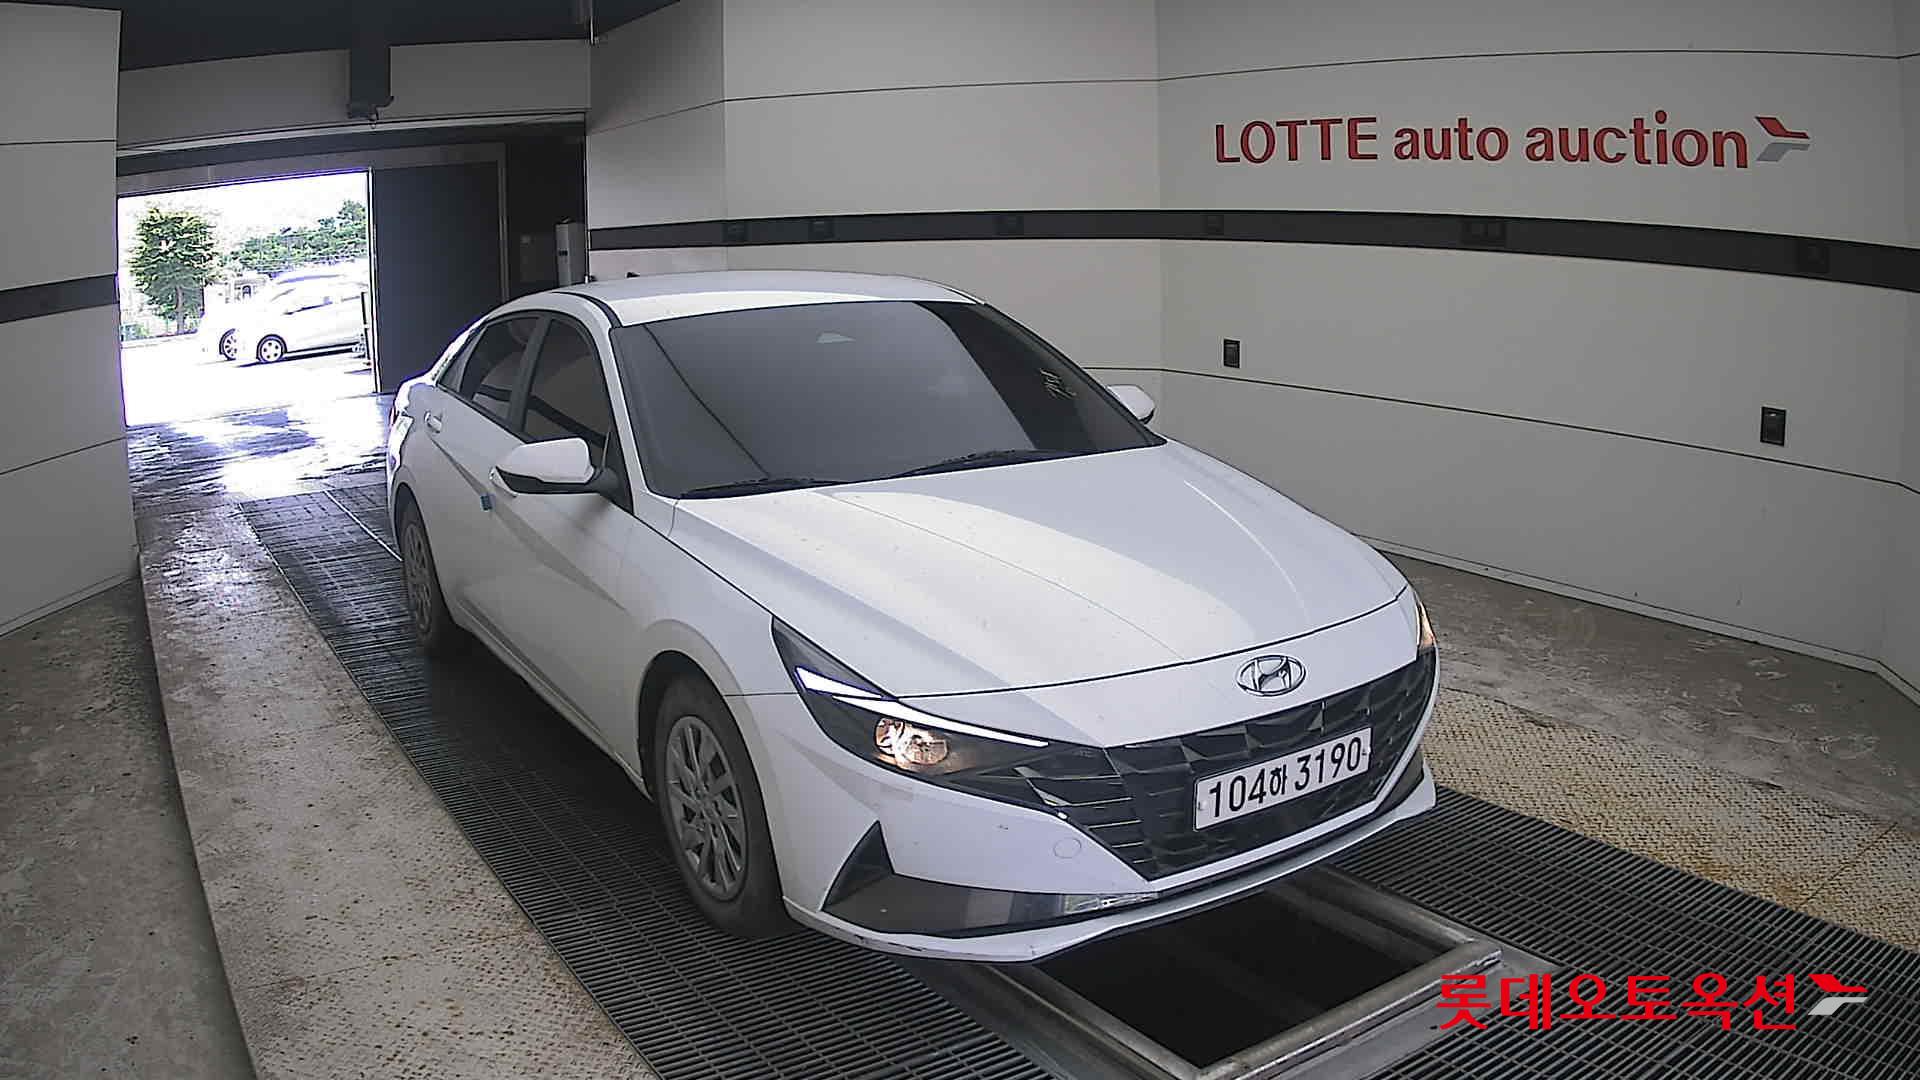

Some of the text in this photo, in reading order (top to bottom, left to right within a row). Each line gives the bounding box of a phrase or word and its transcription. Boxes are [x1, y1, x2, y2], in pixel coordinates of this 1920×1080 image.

[1215, 110, 1749, 169] LOTTE auto auction
[1209, 736, 1362, 818] 104하 3190
